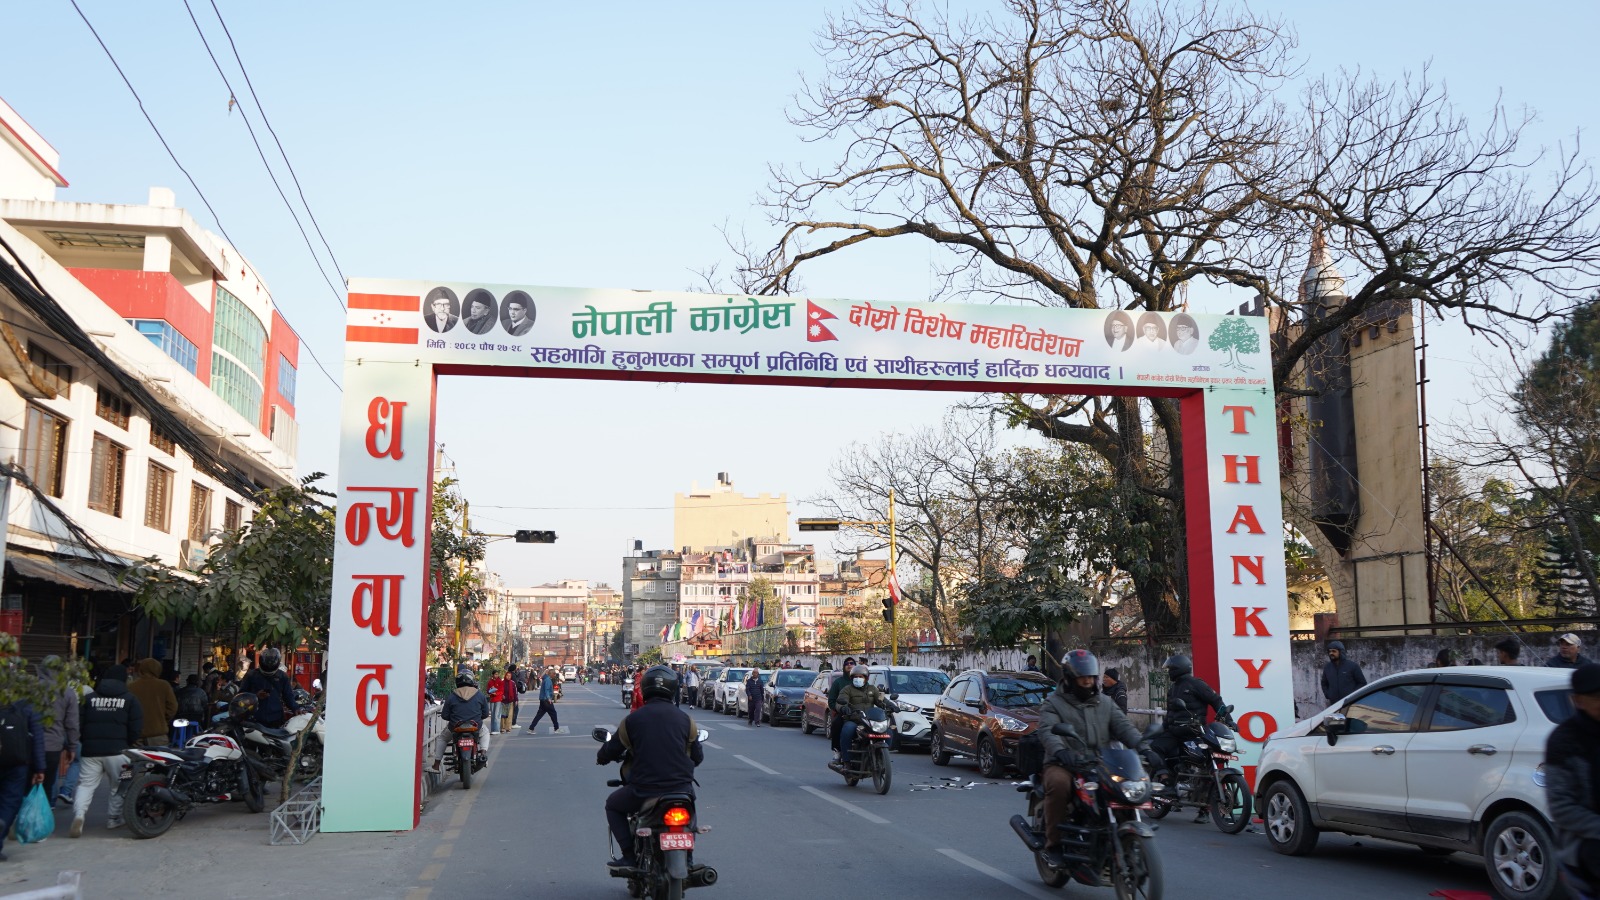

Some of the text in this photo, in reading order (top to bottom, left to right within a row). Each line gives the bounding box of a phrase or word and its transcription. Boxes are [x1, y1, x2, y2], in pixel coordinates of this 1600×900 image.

[571, 297, 796, 339] नेपाली कांग्रेस
[849, 301, 1084, 358] दोस्रो विशेष महाधिवेशन
[426, 338, 446, 349] मिति
[454, 342, 476, 351] २०८२
[530, 344, 606, 365] सहभागि
[611, 349, 695, 370] हुनुभएका
[701, 351, 760, 374] सम्पूर्ण
[766, 350, 838, 372] प्रतिनिधि
[844, 355, 868, 373] एवं
[985, 358, 1040, 378] हार्दिक
[1045, 364, 1111, 381] धन्यवाद
[91, 697, 125, 708] TRAPSTAR
